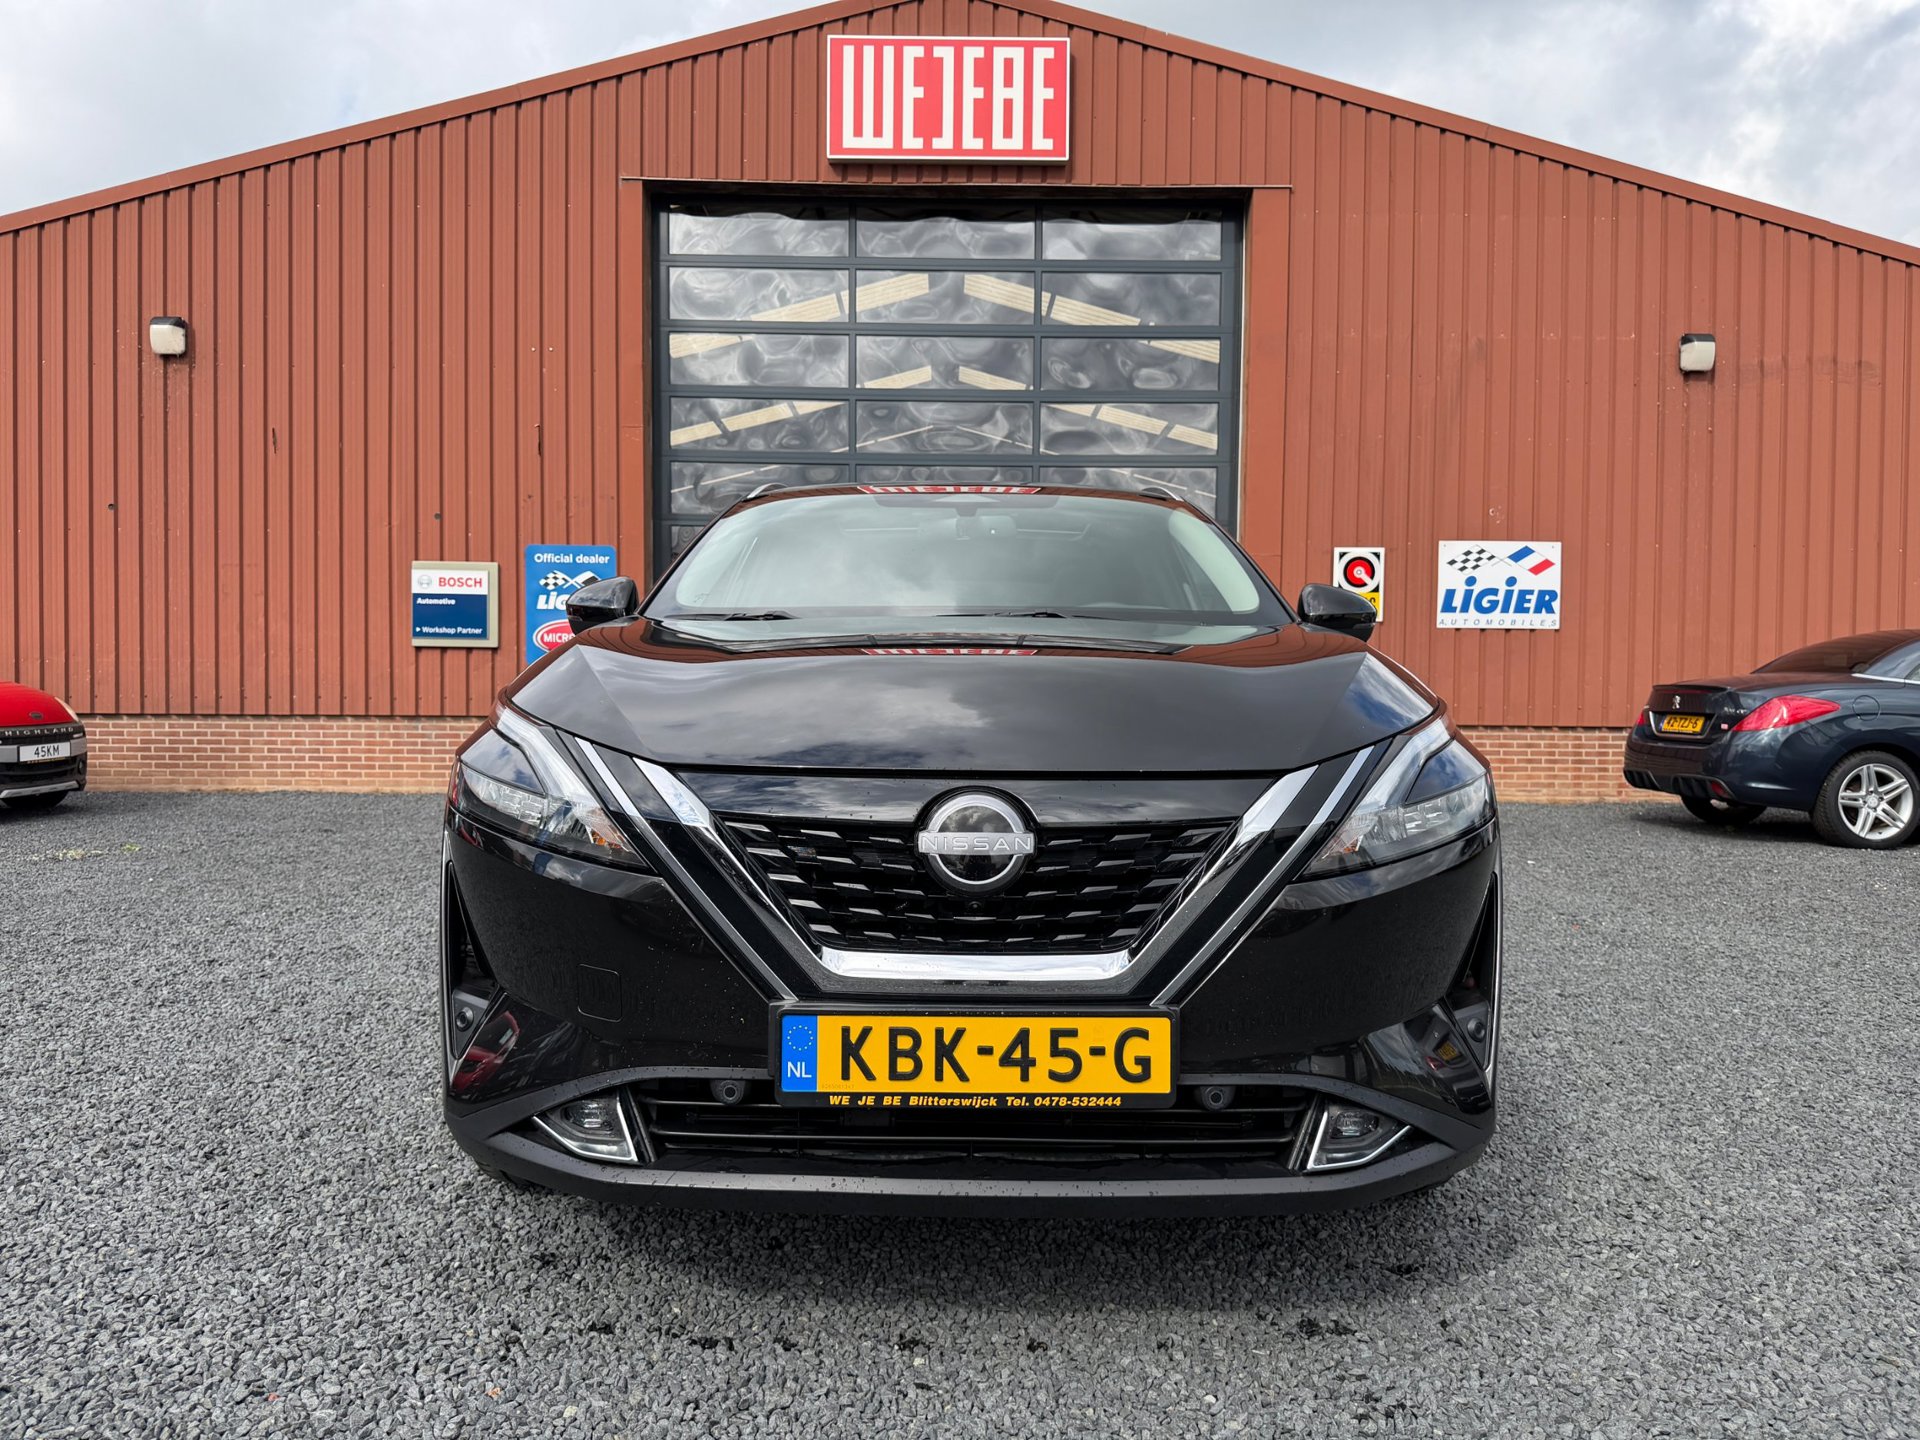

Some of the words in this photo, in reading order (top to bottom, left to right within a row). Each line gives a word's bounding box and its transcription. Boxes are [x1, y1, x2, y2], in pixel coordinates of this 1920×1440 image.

[534, 553, 573, 564] Official
[575, 553, 610, 564] dealer
[438, 577, 483, 588] BOSCH
[536, 591, 570, 610] LIG
[1440, 575, 1558, 614] LIGIER
[416, 597, 456, 606] Automotive
[422, 626, 456, 635] Workshop
[456, 626, 483, 635] Partner
[4, 727, 74, 737] HIGHLAND
[34, 745, 60, 758] 45KM
[921, 836, 1032, 851] NISSAN
[839, 1025, 1152, 1083] KBK-45-G
[787, 1061, 812, 1078] NL
[829, 1096, 851, 1105] WE
[857, 1096, 875, 1106] JE
[883, 1096, 902, 1106] BE
[909, 1096, 998, 1108] Blitterswijck
[1006, 1096, 1030, 1106] Tel.
[1034, 1096, 1122, 1107] 0478-532444
